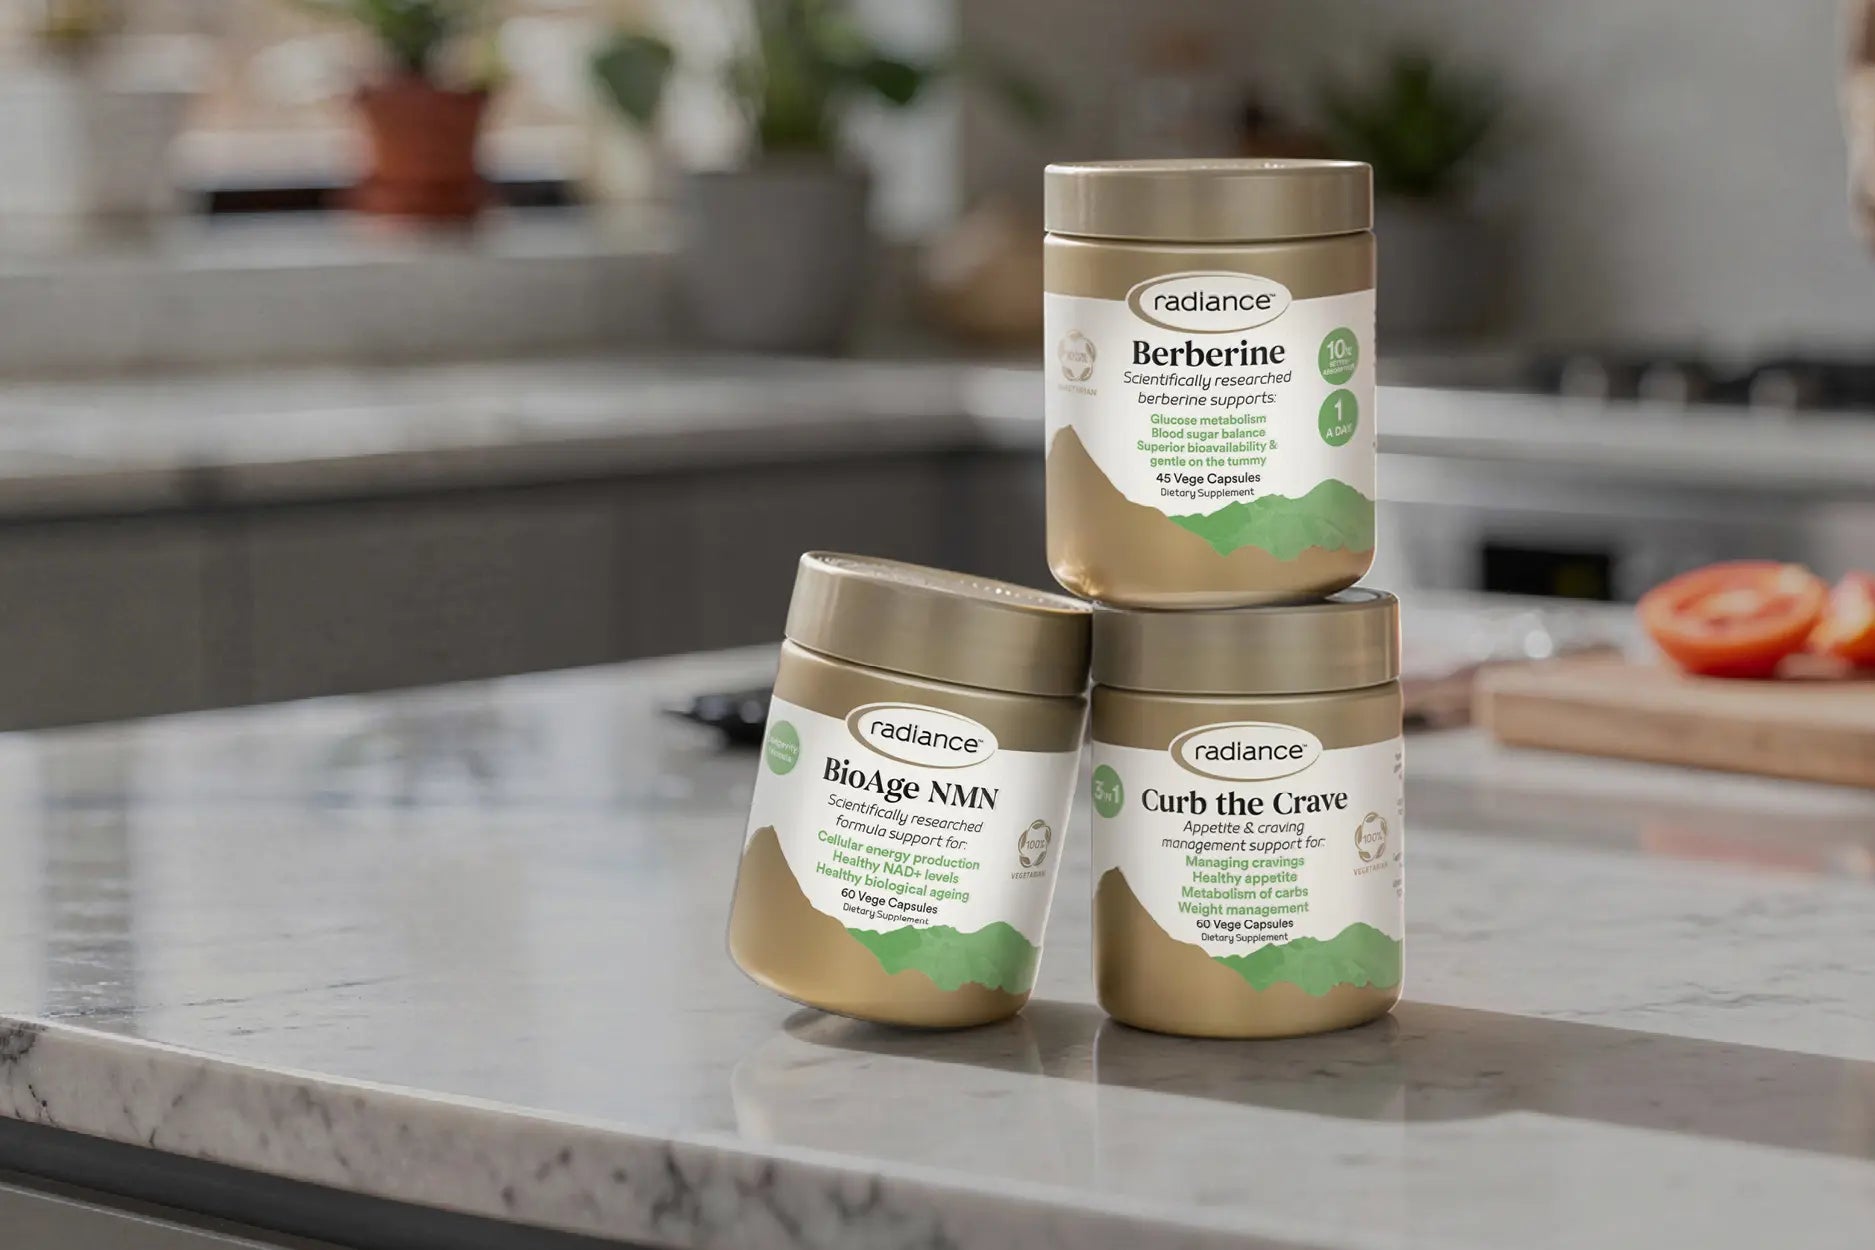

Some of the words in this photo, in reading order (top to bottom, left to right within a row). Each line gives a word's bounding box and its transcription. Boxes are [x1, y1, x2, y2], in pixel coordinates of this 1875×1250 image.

[1132, 340, 1285, 366] Berberine
[1123, 372, 1212, 389] Scientifically
[1214, 371, 1292, 386] researched
[1138, 391, 1206, 406] berberine
[1210, 392, 1276, 408] supports:
[1334, 400, 1342, 421] 1
[1151, 414, 1197, 425] Glucose
[1200, 414, 1266, 425] metabolism
[1152, 428, 1184, 438] Blood
[1186, 430, 1219, 441] sugar
[1222, 428, 1266, 438] balance
[1326, 429, 1334, 437] A
[1335, 423, 1351, 436] DAY
[1137, 441, 1185, 453] Superior
[1187, 441, 1267, 453] bioavailability
[1269, 441, 1277, 451] &
[1150, 456, 1185, 469] gentle
[1189, 458, 1203, 467] on
[1206, 456, 1224, 466] the
[1227, 456, 1267, 468] tummy
[1156, 474, 1171, 484] 45
[1174, 474, 1204, 487] Vege
[1207, 473, 1260, 486] Capsules
[1161, 488, 1195, 499] Dietary
[1198, 488, 1255, 499] Supplement
[823, 757, 920, 803] BioAge
[928, 780, 999, 811] NMN
[1142, 789, 1207, 815] Curb
[1217, 792, 1264, 815] the
[1273, 792, 1348, 814] Crave
[828, 794, 909, 826] Scientifically
[910, 814, 984, 833] researched
[836, 816, 887, 838] formula
[889, 827, 943, 849] support
[1183, 821, 1240, 837] Appetite
[1244, 823, 1254, 833] &
[1257, 821, 1305, 836] craving
[818, 831, 864, 852] Cellular
[866, 843, 911, 862] energy
[913, 851, 980, 871] production
[1162, 839, 1246, 854] management
[1249, 838, 1302, 853] support
[832, 851, 881, 874] Healthy
[883, 861, 922, 878] NAD+
[924, 869, 960, 884] levels
[1186, 856, 1249, 870] Managing
[1252, 856, 1305, 870] cravings
[816, 863, 862, 886] Healthy
[865, 875, 927, 897] biological
[929, 888, 969, 902] ageing
[1193, 872, 1242, 886] Healthy
[1245, 872, 1297, 885] appetite
[1182, 886, 1255, 899] Metabolism
[1258, 888, 1272, 899] of
[1274, 887, 1308, 899] carbs
[841, 888, 856, 899] 60
[858, 890, 886, 909] Vege
[888, 897, 938, 914] Capsules
[843, 903, 875, 919] Dietary
[877, 910, 929, 925] Supplement
[1179, 902, 1223, 916] Weight
[1226, 902, 1309, 917] management
[1197, 919, 1211, 929] 60
[1213, 919, 1242, 932] Vege
[1244, 919, 1294, 932] Capsules
[1202, 933, 1234, 943] Dietary
[1236, 933, 1288, 943] Supplement
